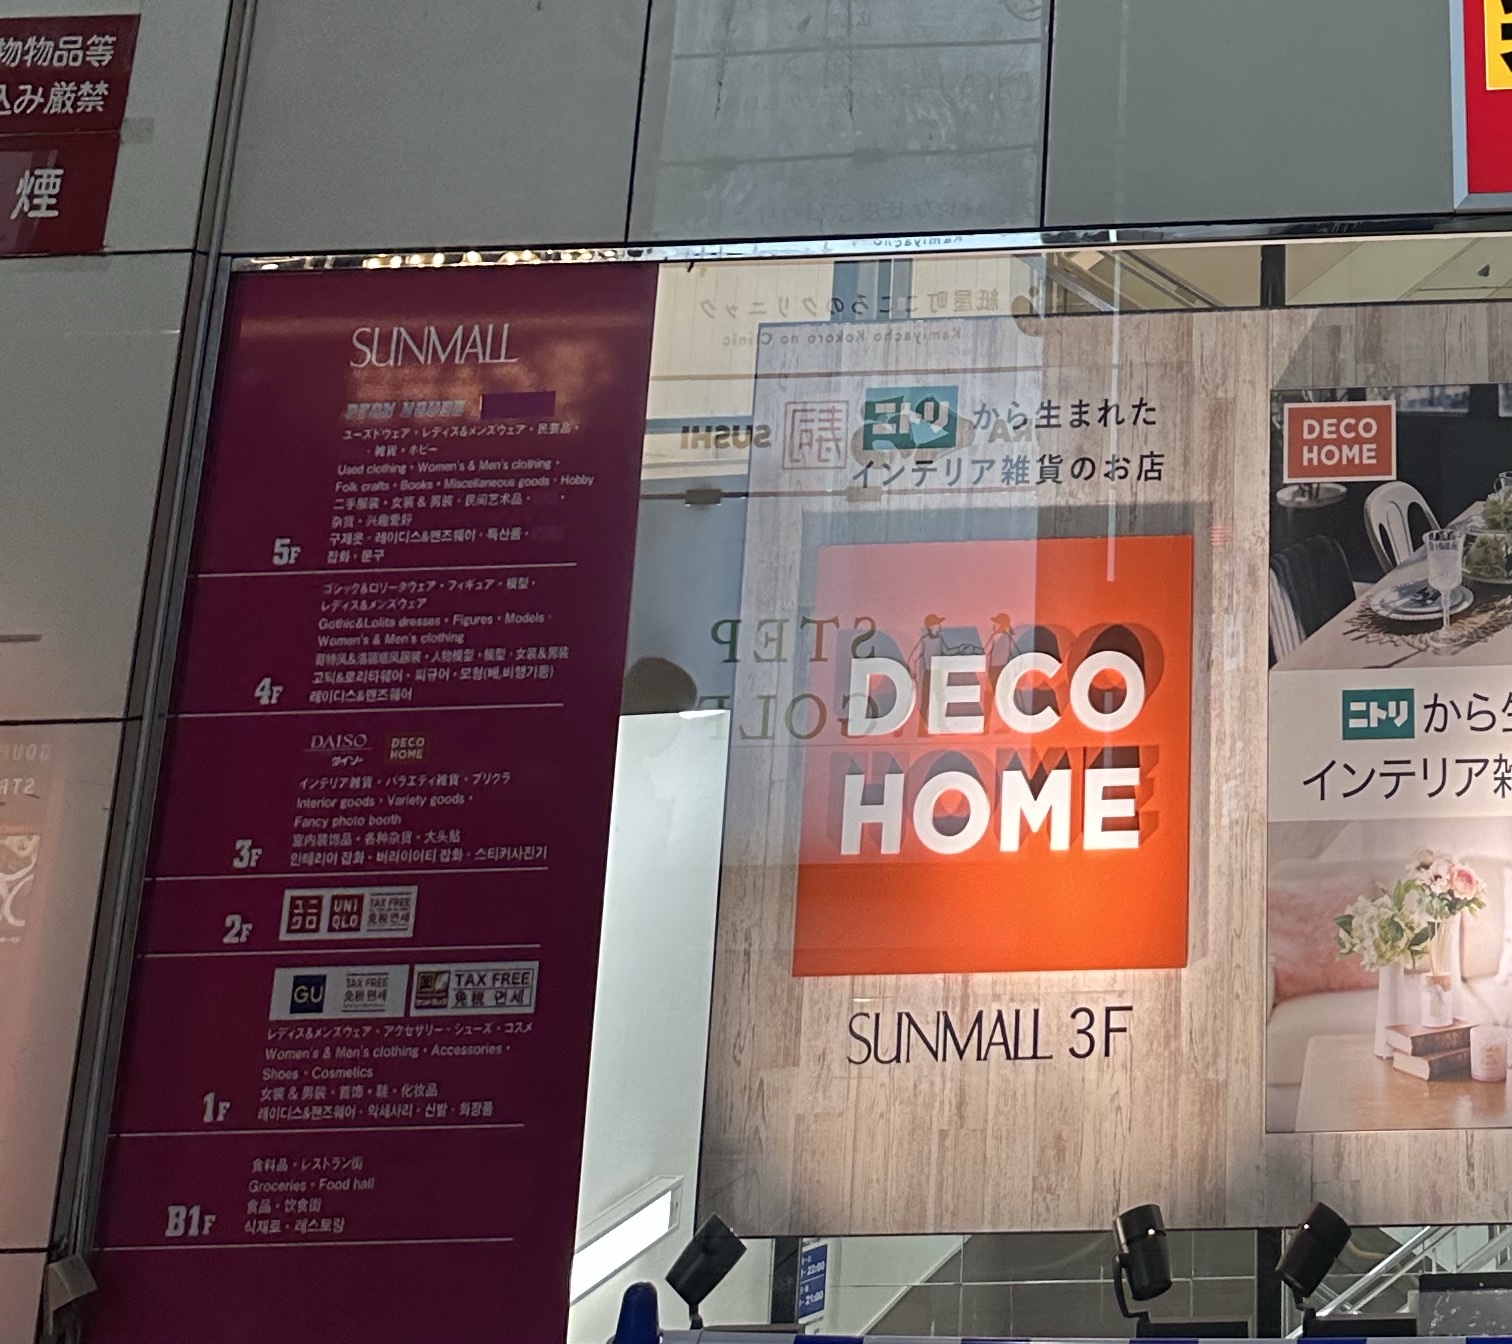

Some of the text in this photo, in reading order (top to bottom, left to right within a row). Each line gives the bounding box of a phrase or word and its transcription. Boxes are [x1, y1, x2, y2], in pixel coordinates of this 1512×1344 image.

[350, 323, 519, 367] SUNMALL
[972, 396, 1160, 431] から生まれた
[1302, 417, 1377, 440] DECO
[1302, 444, 1377, 467] HOME
[418, 459, 465, 473] Women's
[511, 458, 552, 470] clothing
[852, 450, 1166, 490] インテリア雑貨のお店
[400, 478, 433, 491] Books
[560, 474, 594, 486] Hobby
[272, 538, 301, 566] 5F
[453, 613, 494, 627] Figures
[505, 612, 545, 624] Models
[318, 632, 465, 647] Women's & Men's clothing
[254, 677, 284, 705] 4F
[848, 649, 1146, 735] DECO
[1349, 699, 1409, 729] ニトリ
[310, 733, 425, 749] DAISO DECO
[390, 749, 423, 761] HOME
[296, 793, 465, 810] Interior goods Variety goods
[840, 766, 1142, 856] HOME
[293, 813, 402, 828] Fancy photo booth
[233, 839, 263, 869] 3F
[293, 899, 319, 913] ユニ
[334, 898, 359, 912] UNI
[222, 914, 254, 944] 2F
[290, 915, 317, 930] クロ
[331, 914, 359, 930] QLO
[455, 972, 531, 987] TAX FREE
[293, 985, 324, 1004] GU
[846, 1004, 1133, 1066] SUNMALL 3F
[265, 1043, 502, 1060] Women's & Men's clothing Accessories
[262, 1065, 374, 1081] Shoes Cosmetics
[202, 1092, 230, 1123] 1F
[248, 1176, 375, 1193] Groceries Food hall
[165, 1205, 216, 1237] B1F
